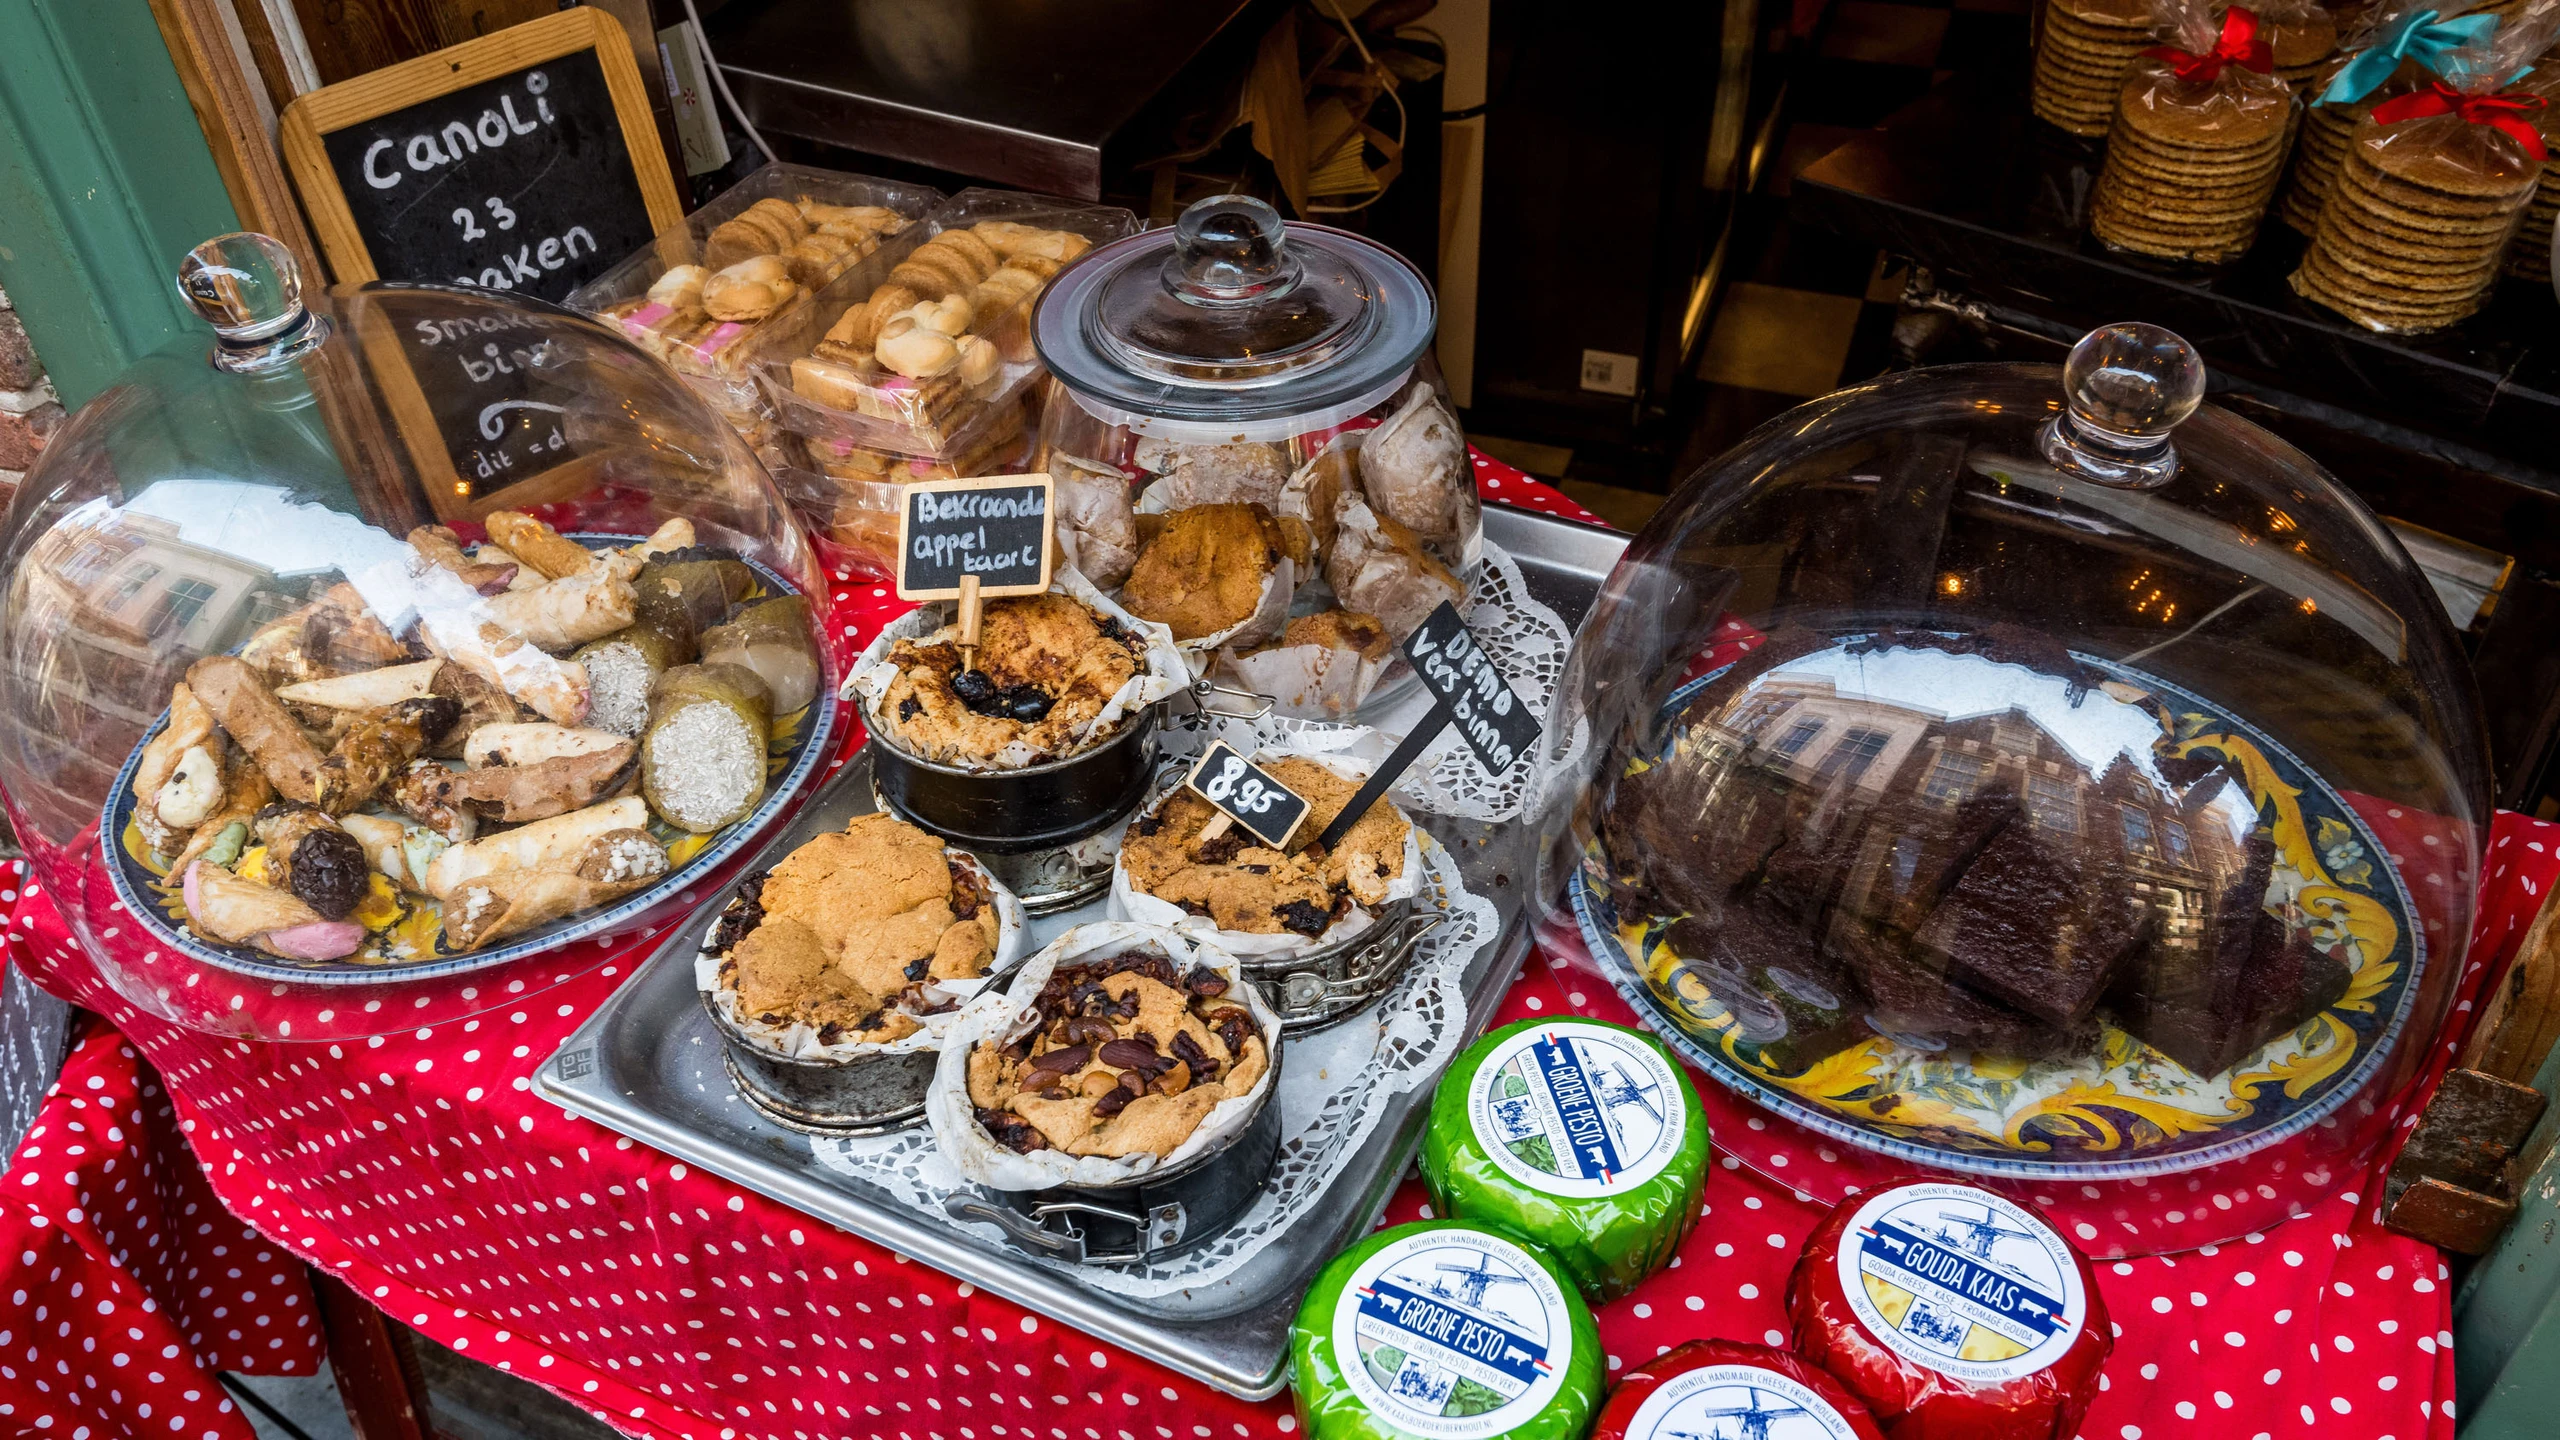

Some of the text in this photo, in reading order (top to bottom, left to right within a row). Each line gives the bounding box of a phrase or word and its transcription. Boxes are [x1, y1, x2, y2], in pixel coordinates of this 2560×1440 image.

[914, 525, 986, 567] appel
[1445, 629, 1512, 716] DEMO
[1207, 756, 1287, 814] 8.95
[1481, 1067, 1493, 1081] SINCE
[1522, 1054, 1537, 1071] GREEN
[1529, 1070, 1543, 1088] PESTO
[1548, 1066, 1605, 1145] GROENE PESTO
[1611, 1035, 1678, 1154] AUTHENTIC HANDMADE CHEESE FROM HOLLAND
[1547, 1116, 1561, 1134] PESTO
[1556, 1138, 1570, 1158] PESTO
[1562, 1157, 1577, 1173] VERT
[1908, 1188, 2071, 1266] AUTHENTIC HANDMADE CHEESE FROM HOLLAND
[1408, 1235, 1557, 1306] AUTHENTIC HANDMADE CHEESE FROM HOLLAND
[1868, 1259, 1896, 1278] GOUDA
[1897, 1271, 1929, 1292] CHEESE
[1961, 1302, 2001, 1327] FROMAGE
[2003, 1322, 2033, 1342] GOUDA
[1905, 1242, 2020, 1311] GOUDA KAAS
[1399, 1297, 1505, 1361] GROENE PESTO
[1853, 1297, 1868, 1315] SINCE
[1866, 1315, 1881, 1330] 1974
[1346, 1360, 1359, 1379] SINCE
[1360, 1379, 1371, 1394] 1974
[1362, 1320, 1385, 1335] GREEN
[1386, 1329, 1410, 1346] PESTO
[1444, 1353, 1469, 1371] PESTO
[1474, 1366, 1498, 1383] PESTO
[1498, 1376, 1517, 1392] VERT
[1666, 1371, 1846, 1434] AUTHENTIC HANDMADE CHEESE FROM HOLLAND
